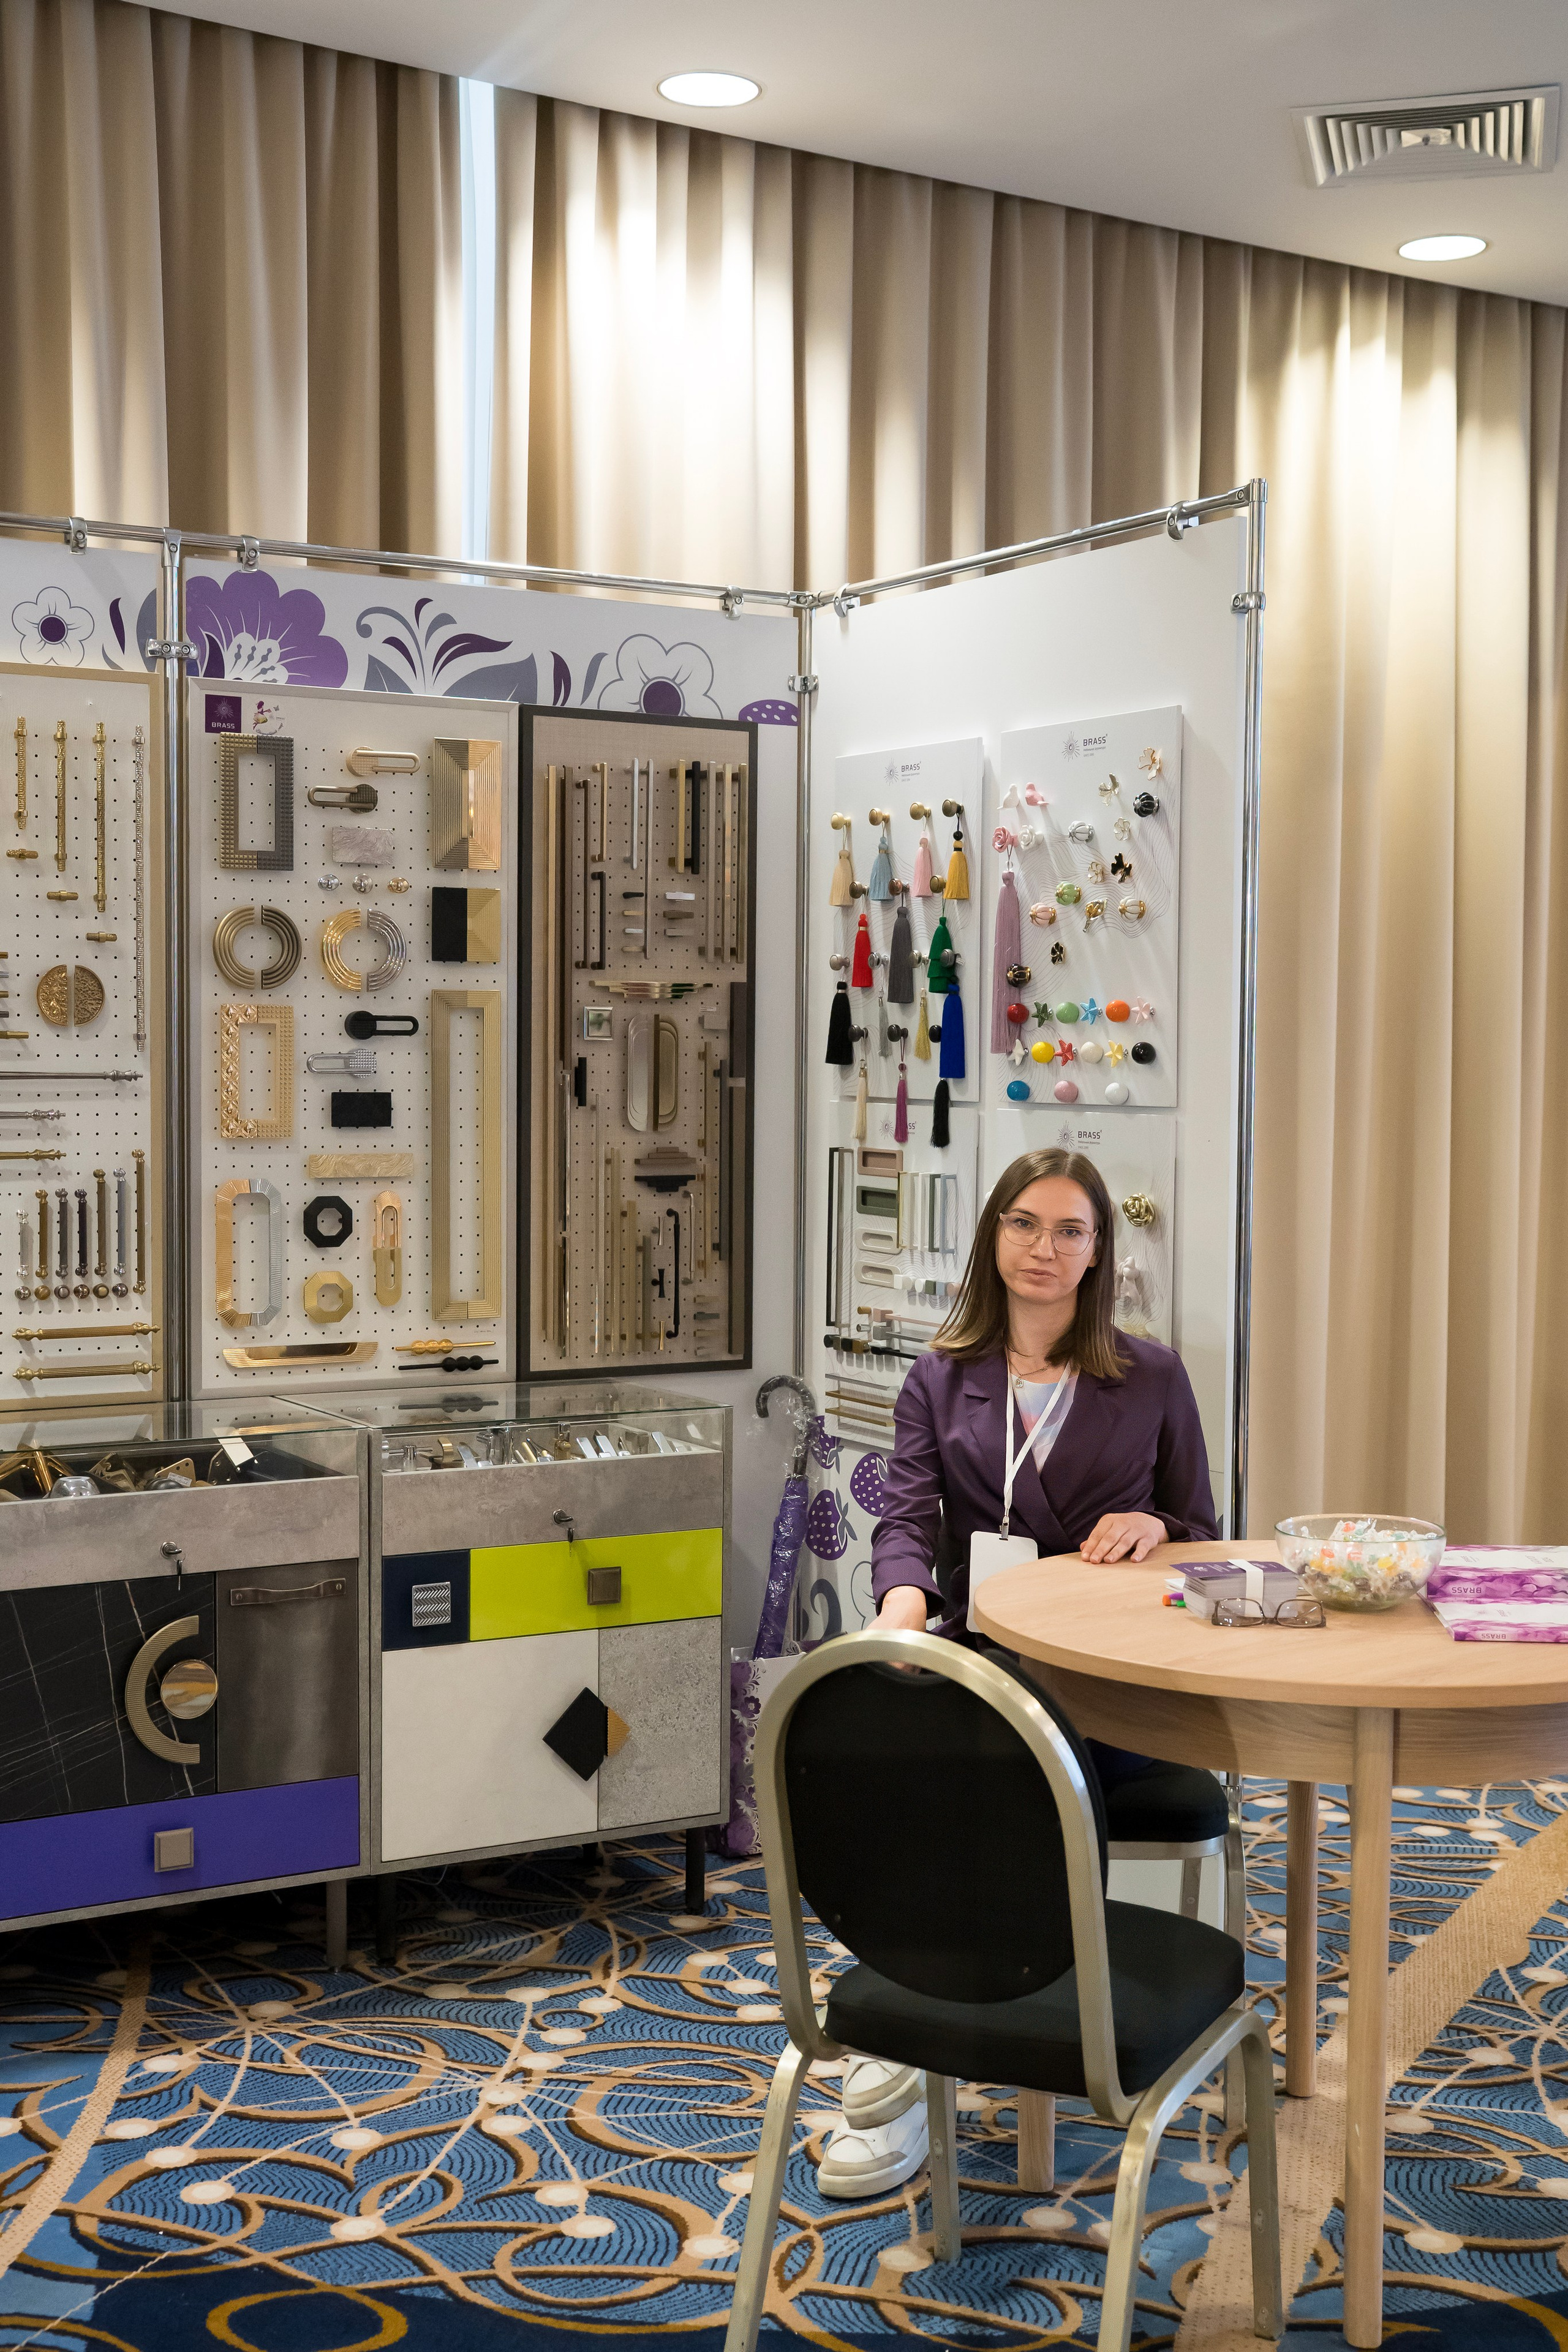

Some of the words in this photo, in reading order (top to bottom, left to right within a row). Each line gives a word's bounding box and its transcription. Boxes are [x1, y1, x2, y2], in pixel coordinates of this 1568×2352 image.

[1083, 736, 1106, 747] BRASS
[901, 763, 920, 772] BRASS
[1077, 1131, 1101, 1139] BRASS
